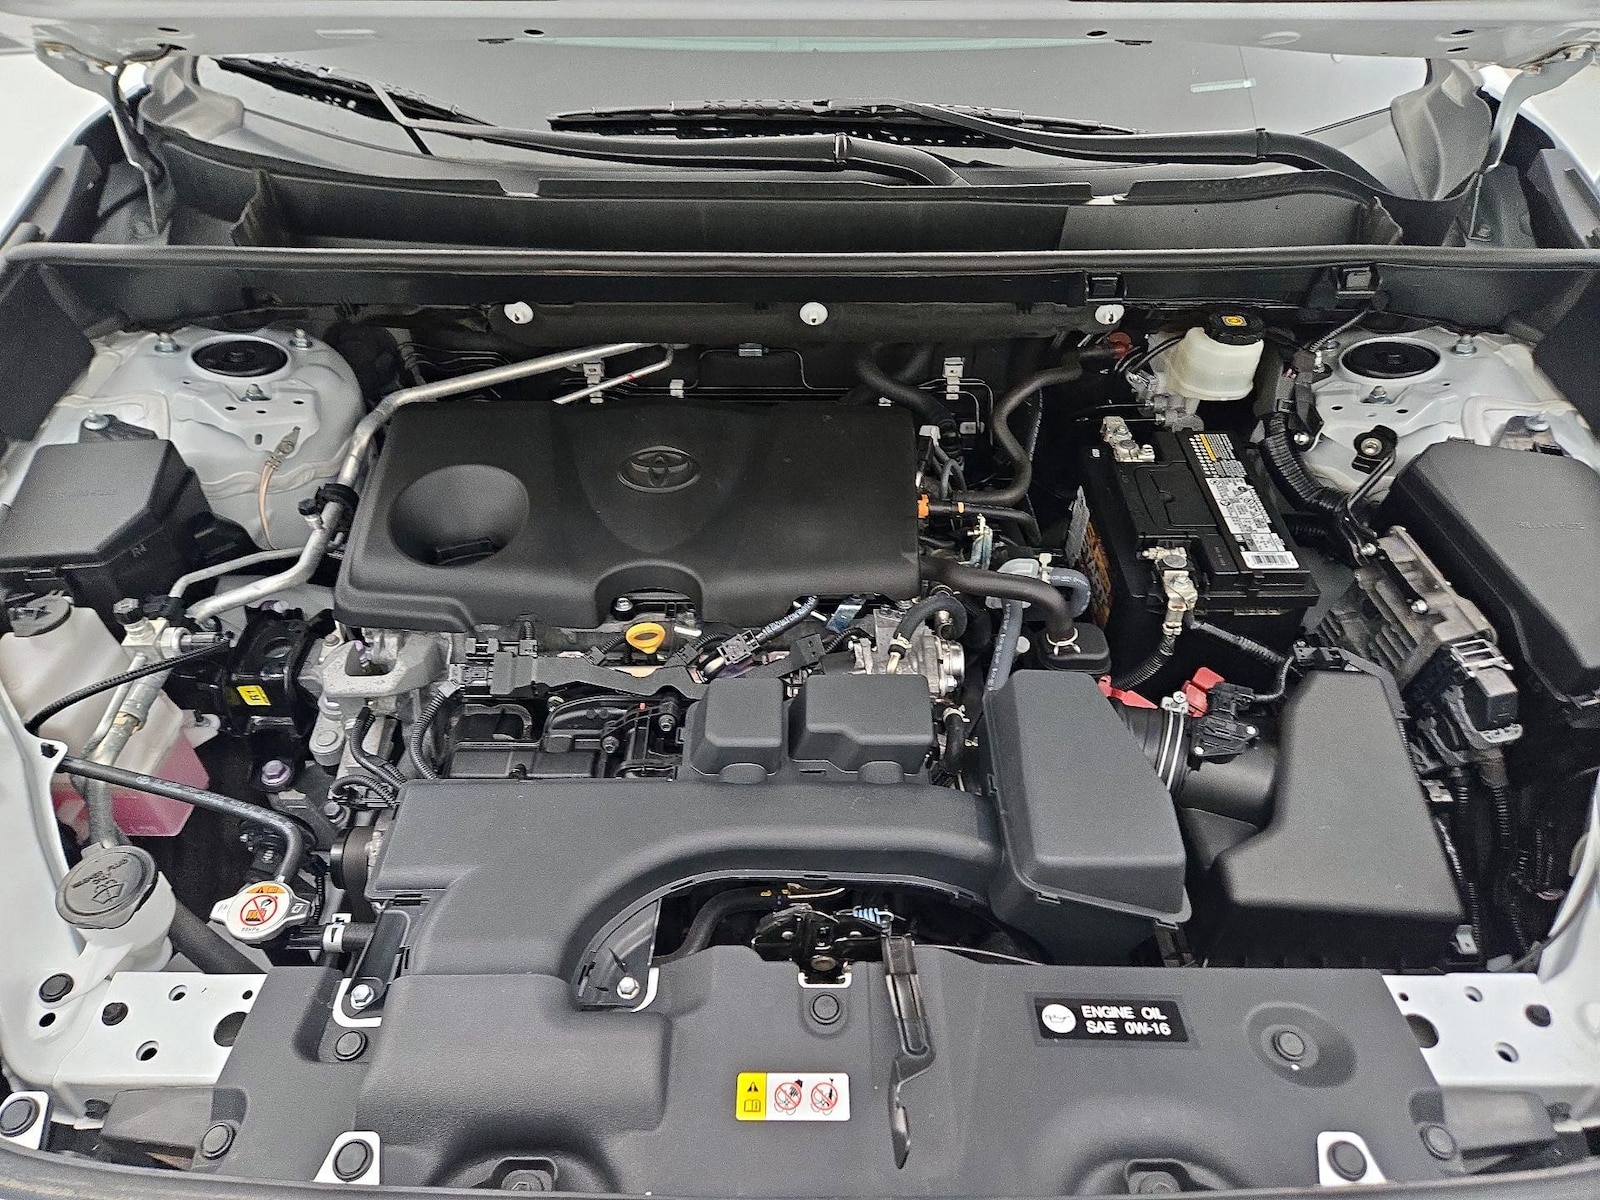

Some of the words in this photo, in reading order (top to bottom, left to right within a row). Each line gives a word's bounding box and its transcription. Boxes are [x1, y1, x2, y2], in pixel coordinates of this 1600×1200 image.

[1081, 1005, 1136, 1019] ENGINE
[1141, 1007, 1168, 1020] OIL
[1086, 1021, 1118, 1034] SAE
[1125, 1022, 1171, 1036] 0W-16
